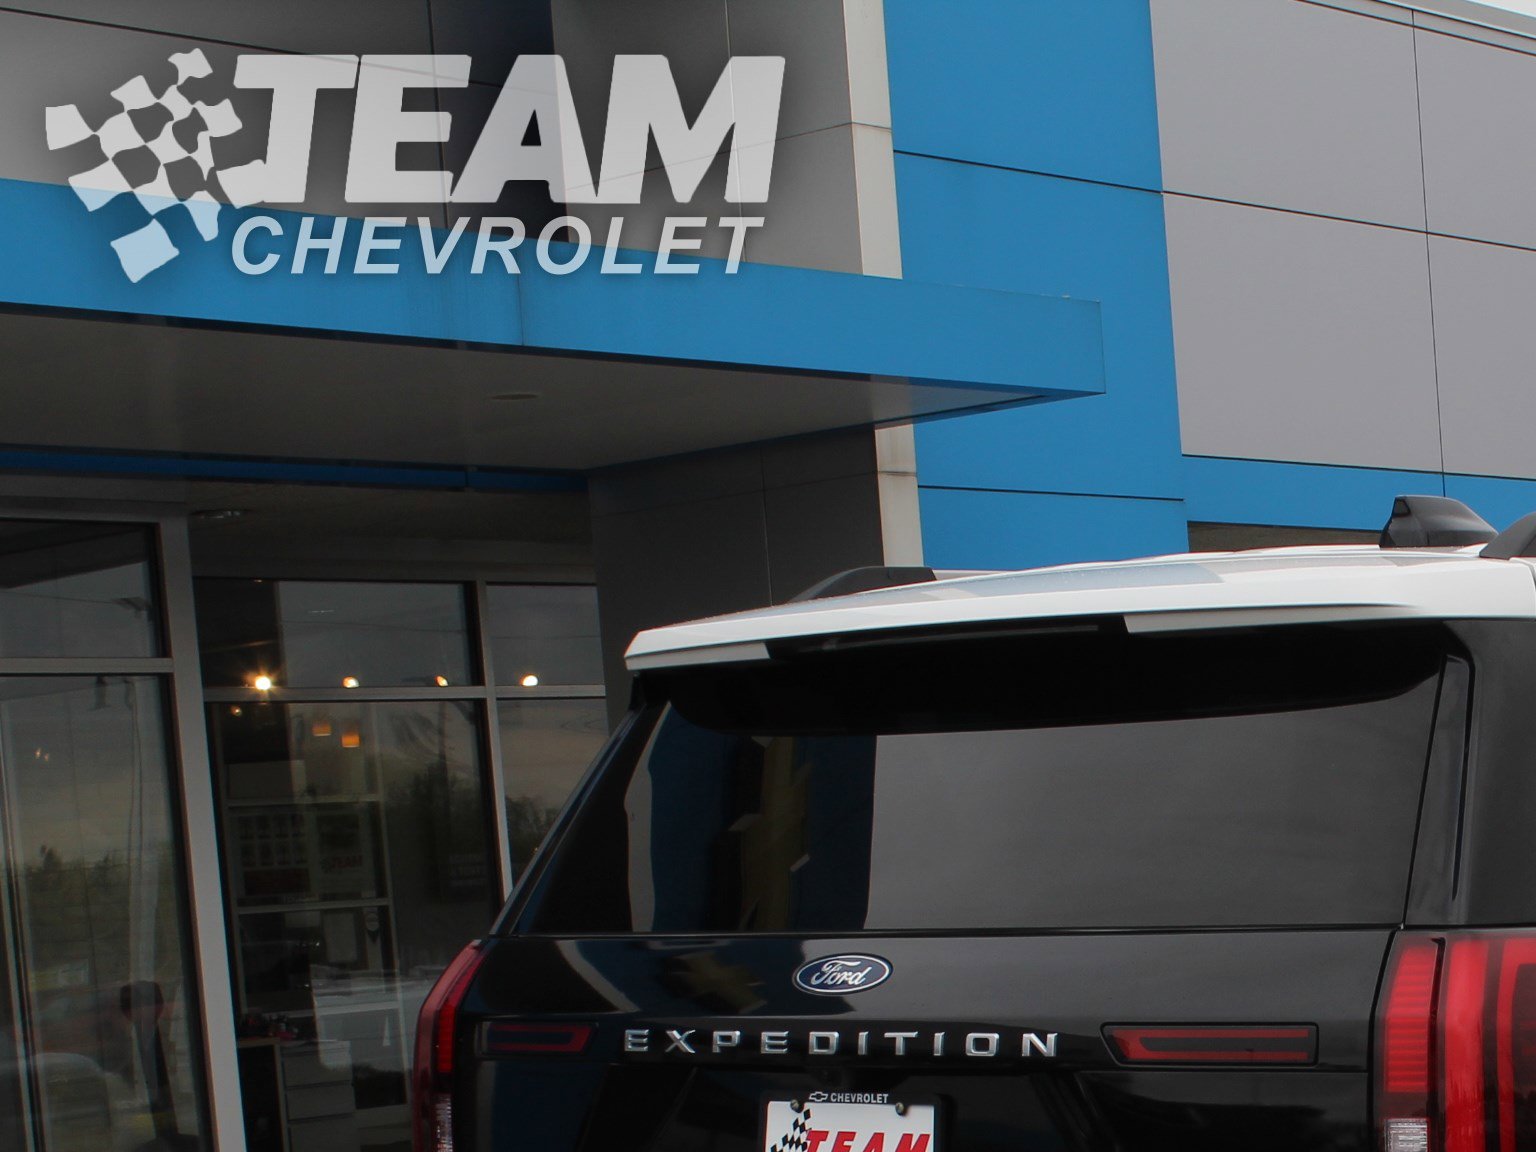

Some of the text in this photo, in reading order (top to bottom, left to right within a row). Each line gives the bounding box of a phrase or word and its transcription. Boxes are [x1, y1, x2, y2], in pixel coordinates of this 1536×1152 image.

[811, 960, 872, 985] Ford
[624, 1029, 1058, 1057] EXPEDITION
[830, 1092, 889, 1104] CHEVROLET
